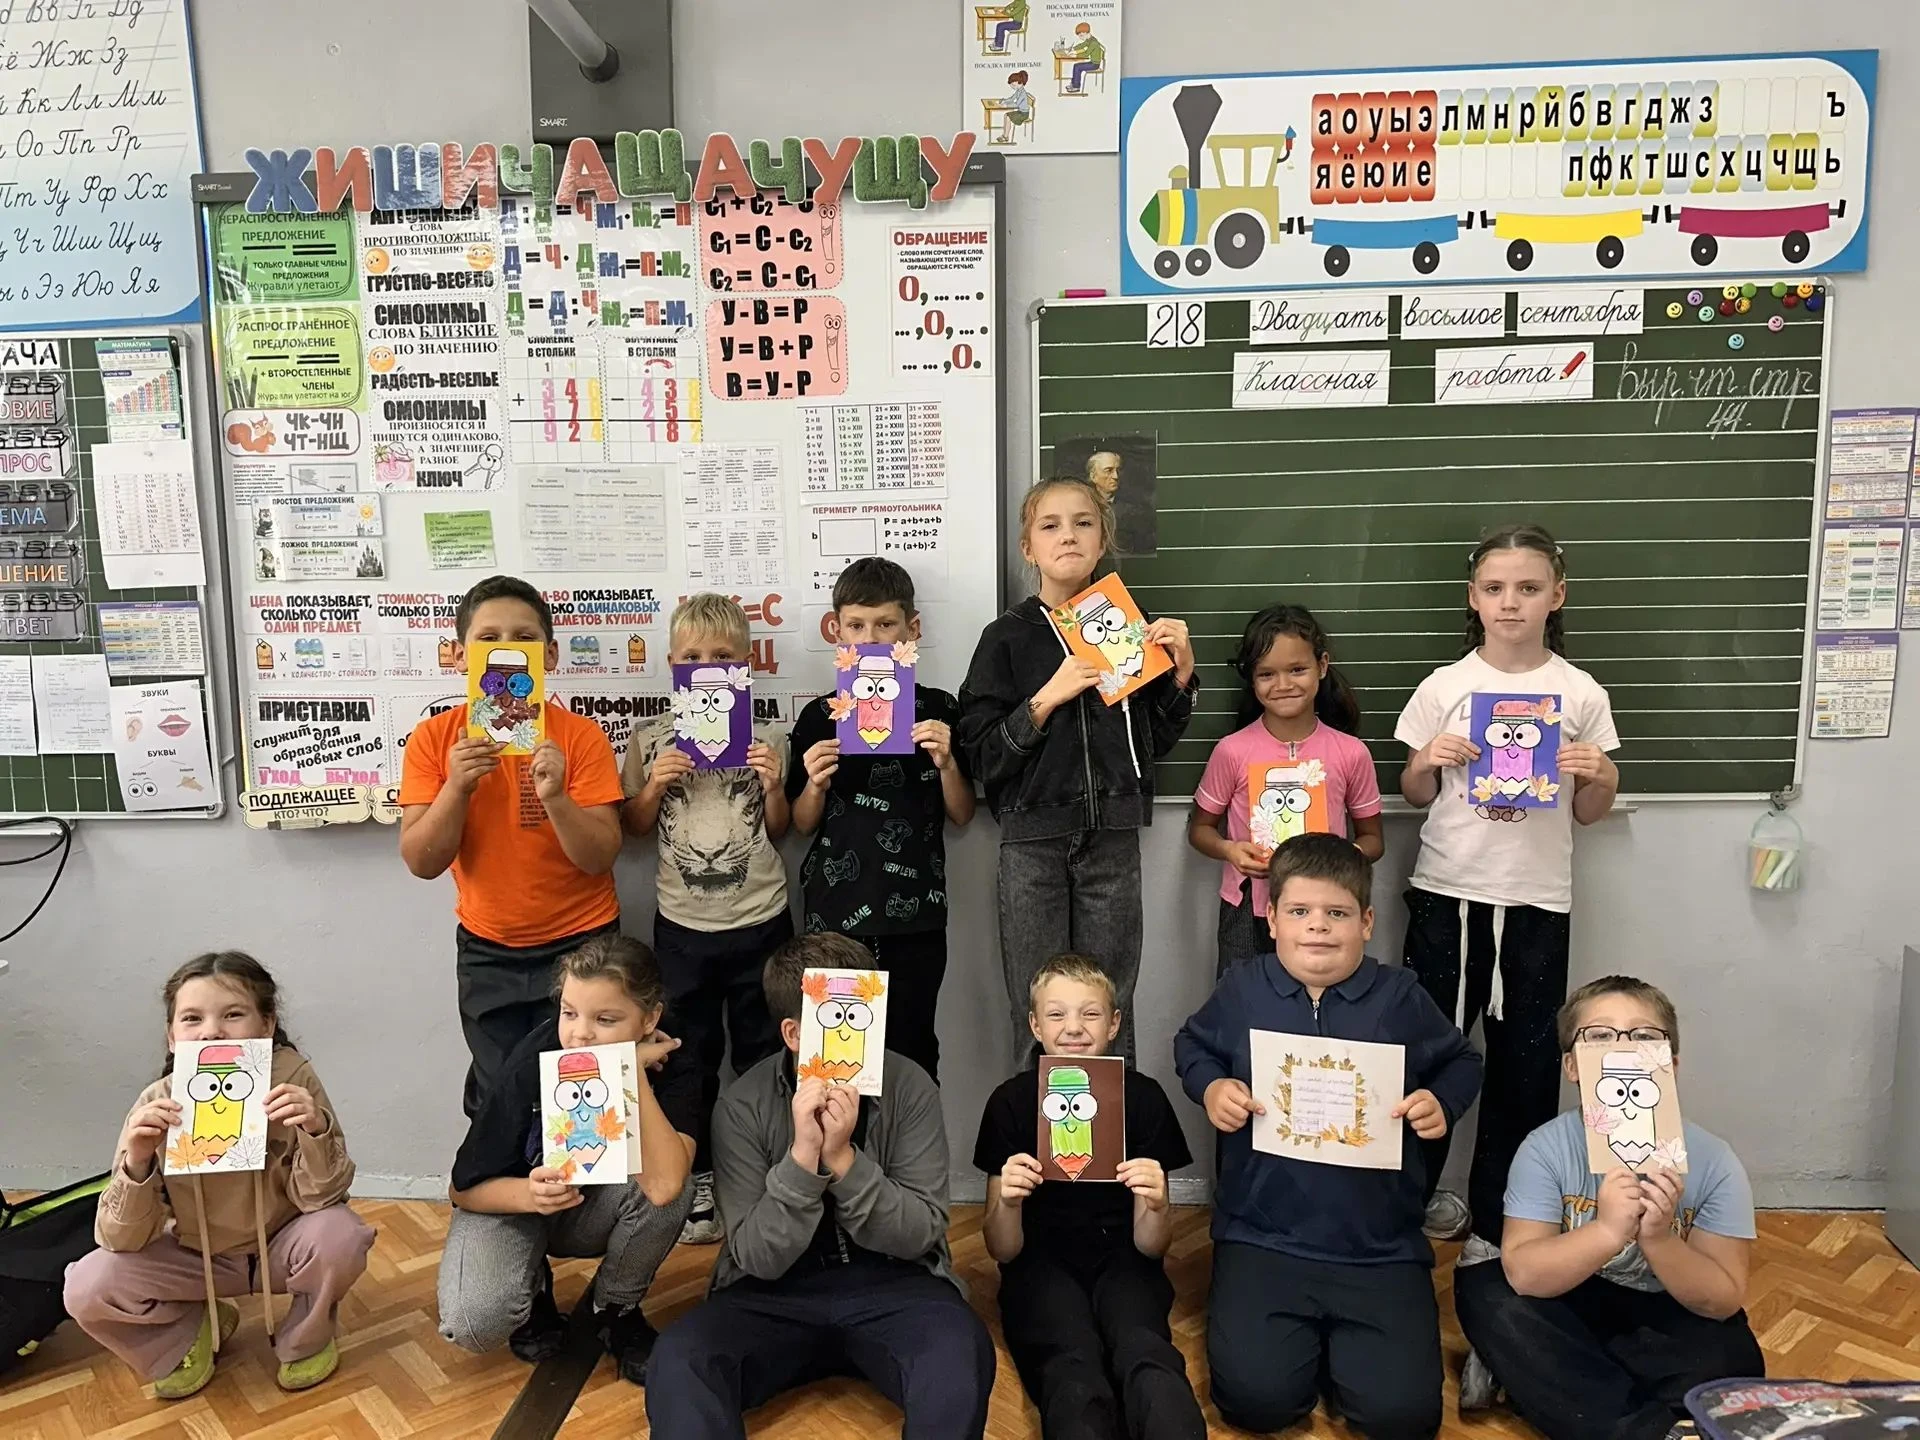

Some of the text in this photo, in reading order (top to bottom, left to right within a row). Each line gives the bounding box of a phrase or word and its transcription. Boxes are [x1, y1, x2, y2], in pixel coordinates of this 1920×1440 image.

[410, 223, 443, 232] СЛОВА
[242, 230, 326, 242] ПРЕДЛОЖЕНИЕ
[364, 231, 492, 247] ПРОТИВОПОЛОЖНЫЕ
[893, 231, 988, 247] ОБРАЩЕНИЕ
[393, 245, 464, 256] ПО ЗНАЧЕНИЮ
[253, 259, 347, 268] ТОЛЬКО ГЛАВНЫЕ ЧЛЕНЫ
[273, 271, 329, 280] ПРЕДЛОЖЕНИЯ
[367, 270, 495, 293] ГРУСТНО-ВЕСЕЛО
[375, 302, 487, 326] СИНОНИМЫ
[1251, 289, 1642, 341] Двадцать восьмое сентября
[368, 324, 498, 339] СЛОВА БЛИЗКИЕ
[253, 337, 336, 350] ПРЕДЛОЖЕНИЕ
[394, 341, 498, 355] ПО ЗНАЧЕНИЮ
[267, 366, 352, 378] ВТОРОСТЕПЕННЫЕ
[1244, 353, 1556, 400] Классная работа
[302, 381, 335, 391] ЧЛЕНЫ
[371, 372, 499, 391] РАДОСТЬ-ВЕСЕЛЬЕ
[384, 400, 487, 421] ОМОНИМЫ
[286, 412, 344, 431] ЧК-ЧН
[389, 421, 486, 431] ПРОИЗНОСЯТСЯ И
[284, 431, 350, 451] ЧТ-НЩ
[373, 432, 502, 443] ПИШУТСЯ ОДИНАКОВО,
[417, 444, 484, 454] А ЗНАЧЕНИЕ
[419, 455, 459, 465] РАЗНОЕ
[416, 471, 463, 488] КЛЮЧ
[272, 496, 355, 505] ПРОСТОЕ ПРЕДЛОЖЕНИЕ
[813, 503, 943, 515] ПЕРИМЕТР ПРЯМОУГОЛЬНИКА
[377, 593, 445, 605] СТОИМОСТЬ
[573, 589, 655, 601] ПОКАЗЫВАЕТ,
[250, 595, 373, 609] ЦЕНА ПОКАЗЫВАЕТ,
[578, 601, 661, 613] ОДИНАКОВЫХ
[261, 608, 360, 621] СКОЛЬКО СТОИТ
[378, 605, 430, 617] СКОЛЬКО
[408, 618, 431, 629] ВСЯ
[605, 612, 653, 625] КУПИЛИ
[264, 621, 362, 634] ОДИН ПРЕДМЕТ
[566, 665, 645, 675] КОЛИЧЕСТВО ЦЕНА
[141, 689, 169, 698] ЗВУКИ
[259, 701, 371, 722] ПРИСТАВКА
[570, 696, 671, 717] СУФФИКС
[601, 719, 630, 733] для
[253, 724, 341, 749] служит для
[147, 749, 176, 757] БУКВЫ
[273, 733, 362, 763] образования
[296, 736, 383, 770] новых слов
[258, 769, 380, 786] УХОД ВЫХОД
[250, 787, 356, 808] ПОДЛЕЖАЩЕЕ
[853, 793, 890, 812] GAME
[273, 807, 330, 820] КТО? ЧТО?
[883, 861, 901, 874] NEW
[842, 904, 872, 930] GAME
